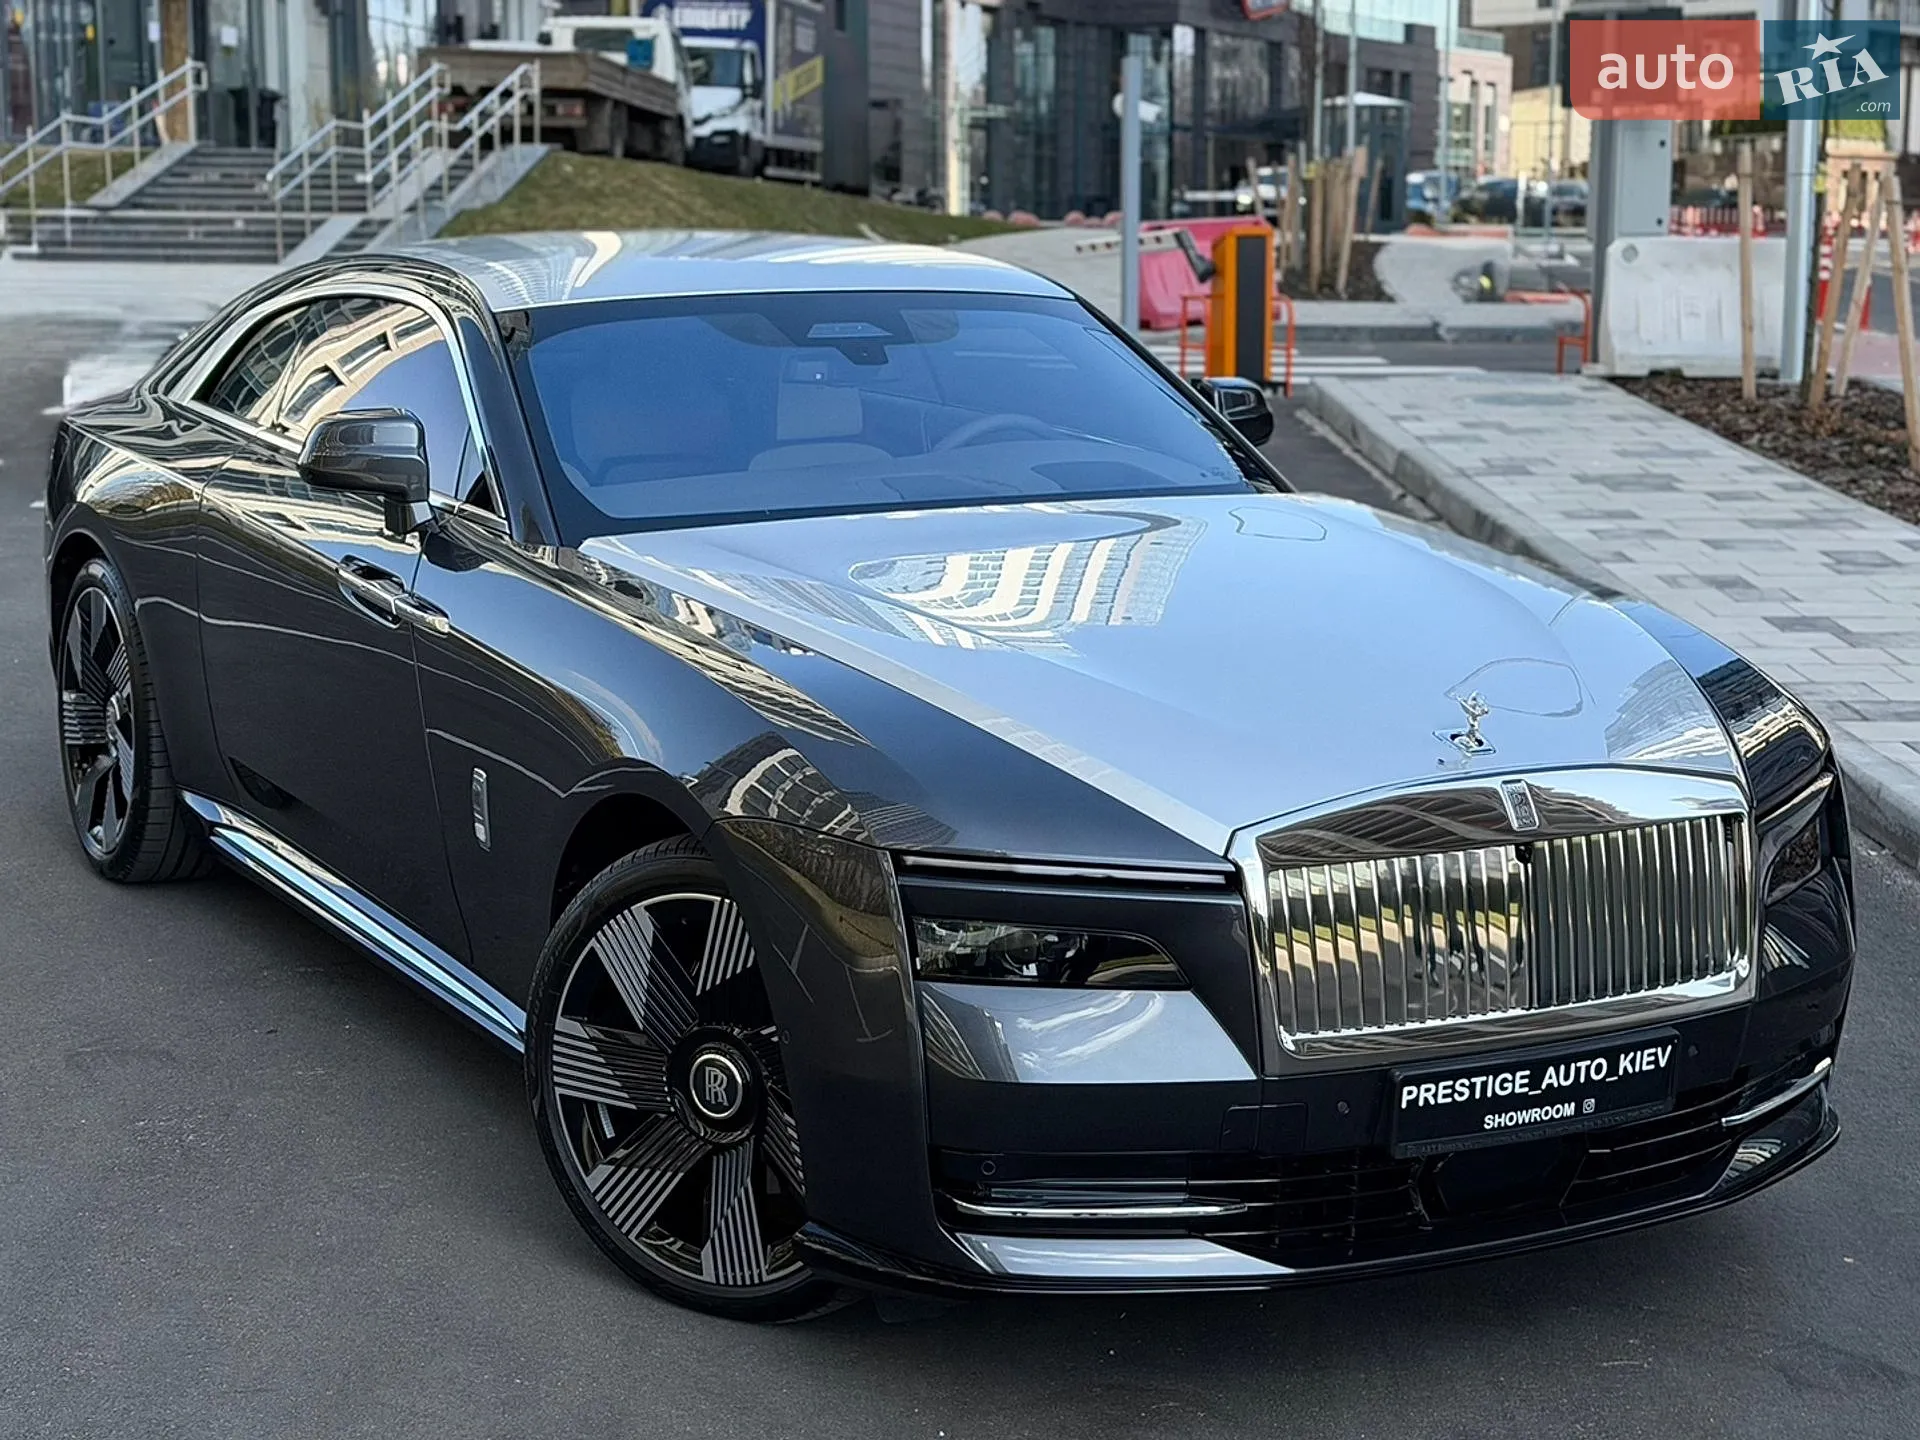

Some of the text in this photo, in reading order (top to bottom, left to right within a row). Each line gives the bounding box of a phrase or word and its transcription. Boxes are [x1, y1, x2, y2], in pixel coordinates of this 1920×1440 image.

[705, 1066, 729, 1106] RR
[1401, 1045, 1672, 1109] PRESTIGE_AUTO_KIEV
[1484, 1102, 1576, 1130] SHOWROOM
